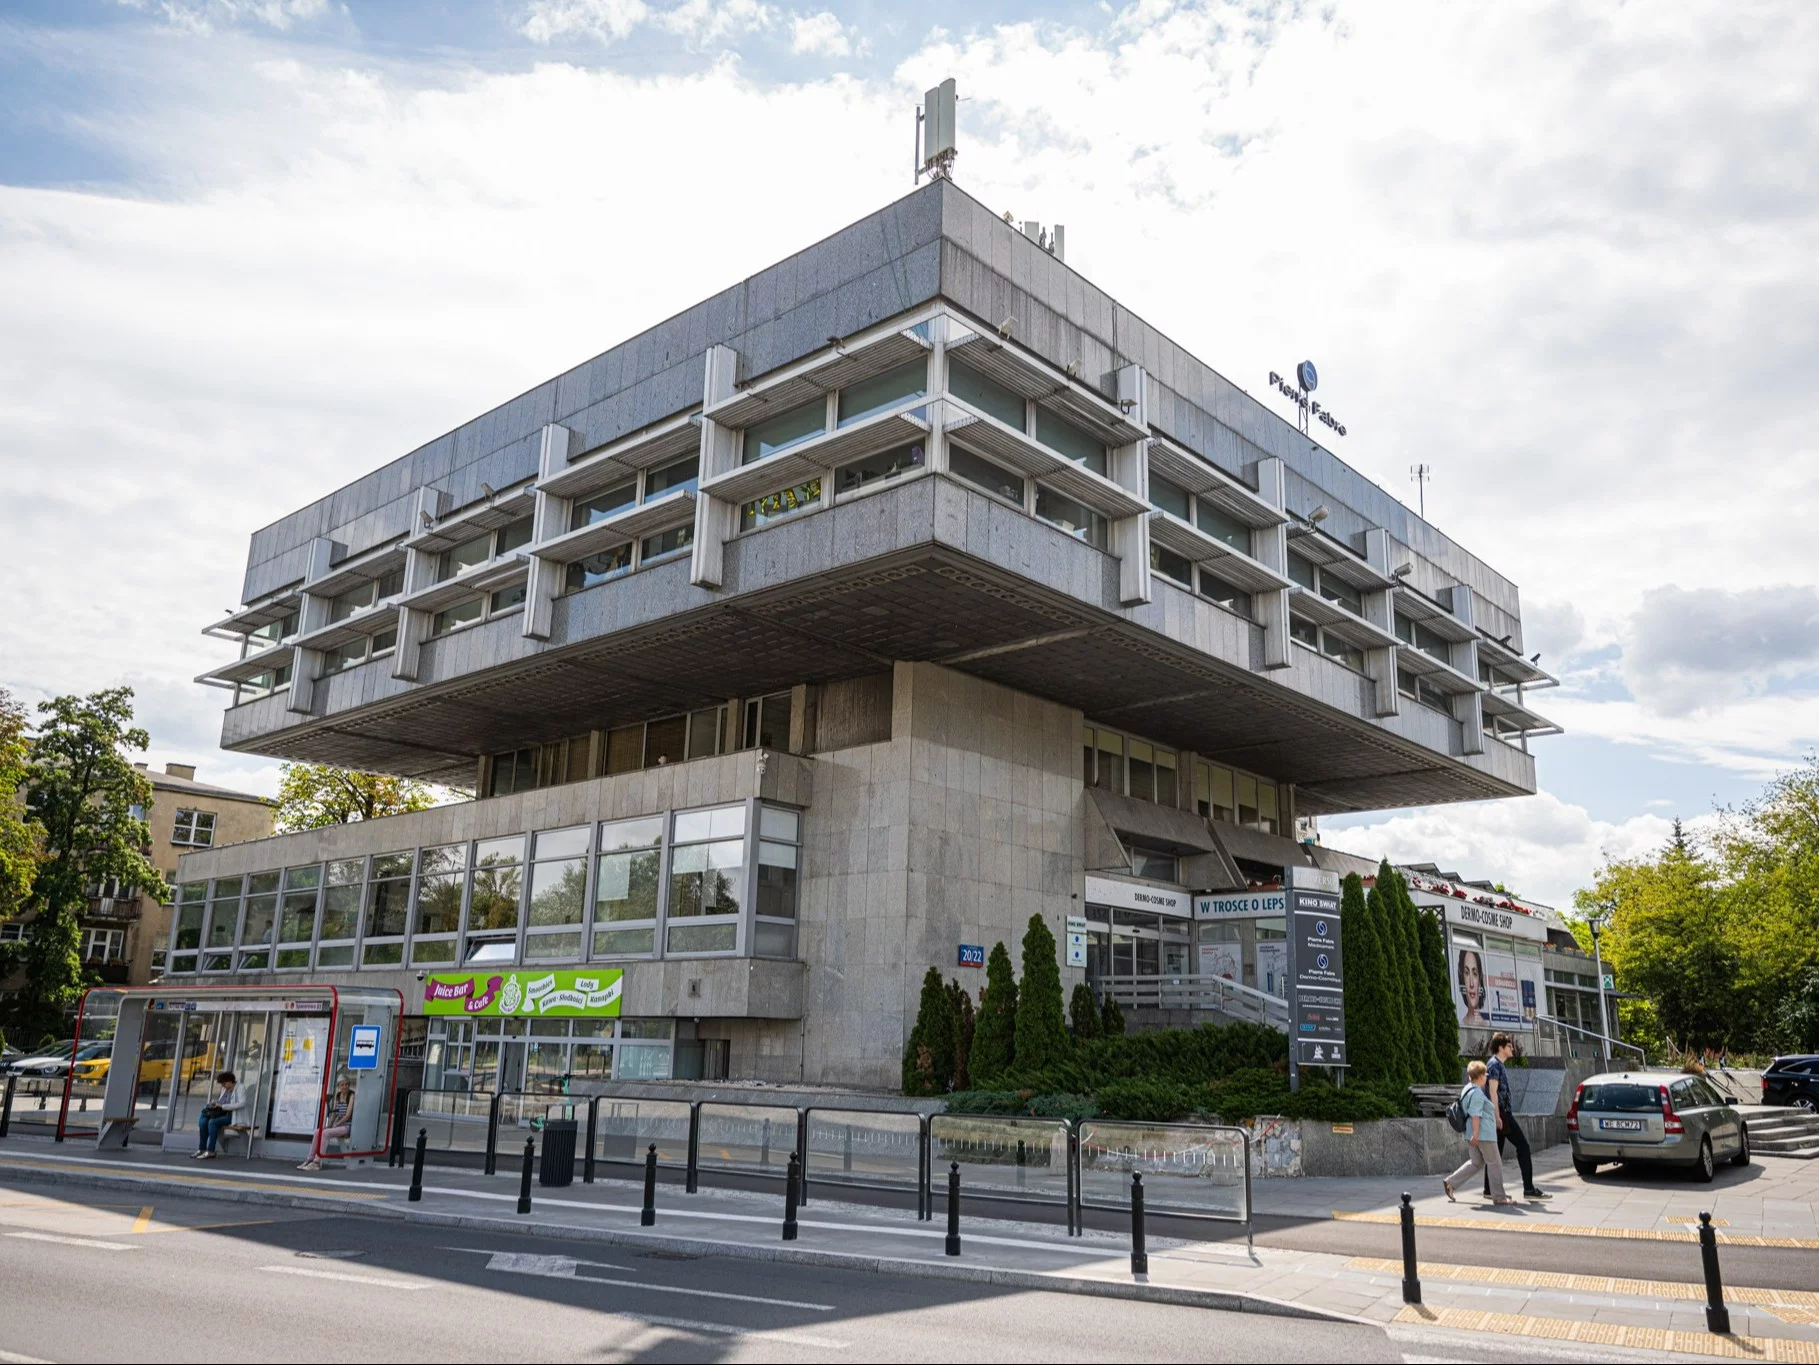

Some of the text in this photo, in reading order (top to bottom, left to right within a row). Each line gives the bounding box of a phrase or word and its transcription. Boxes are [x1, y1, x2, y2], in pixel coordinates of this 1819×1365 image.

[1269, 371, 1347, 436] Pierre Fabre
[1134, 892, 1177, 908] DERMO-COSME SHOP
[1200, 897, 1285, 914] W TROSCE O LEPS
[1460, 905, 1513, 930] DERMO-COSME SHOP
[963, 949, 982, 961] 20/22
[434, 983, 469, 997] Juice Bar
[580, 980, 595, 990] Lody
[542, 993, 557, 1008] Kawa
[590, 988, 614, 1004] Kanapki
[467, 1001, 474, 1011] &
[1605, 1119, 1613, 1128] WE
